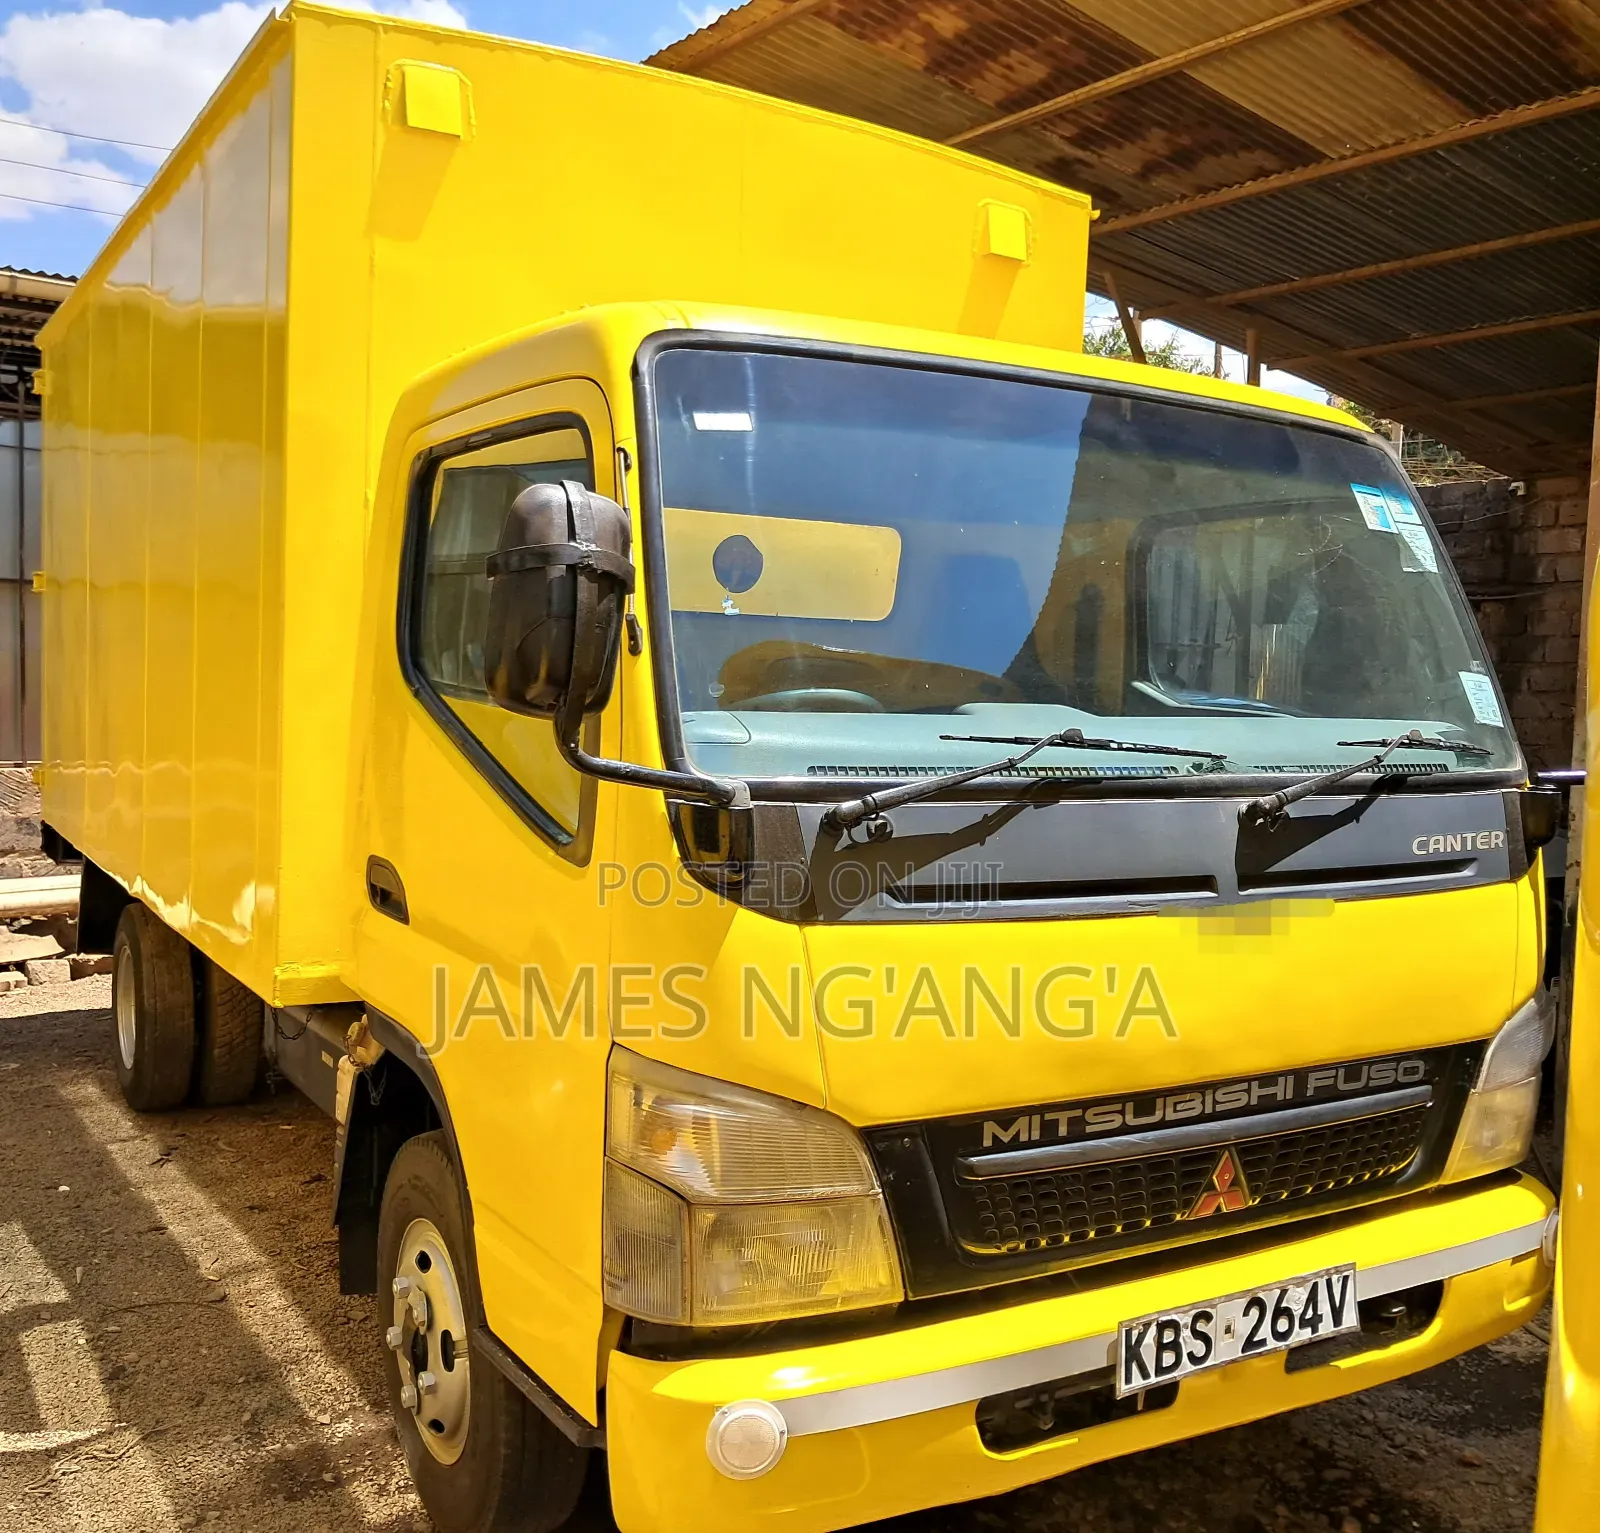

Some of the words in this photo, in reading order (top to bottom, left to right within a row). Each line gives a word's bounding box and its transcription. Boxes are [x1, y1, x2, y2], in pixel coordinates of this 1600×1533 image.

[1412, 830, 1505, 856] CANTER
[982, 1074, 1295, 1147] MITSUBISHI
[1306, 1059, 1426, 1097] FUSO
[1124, 1309, 1214, 1386] KBS
[1241, 1274, 1350, 1355] 264V
